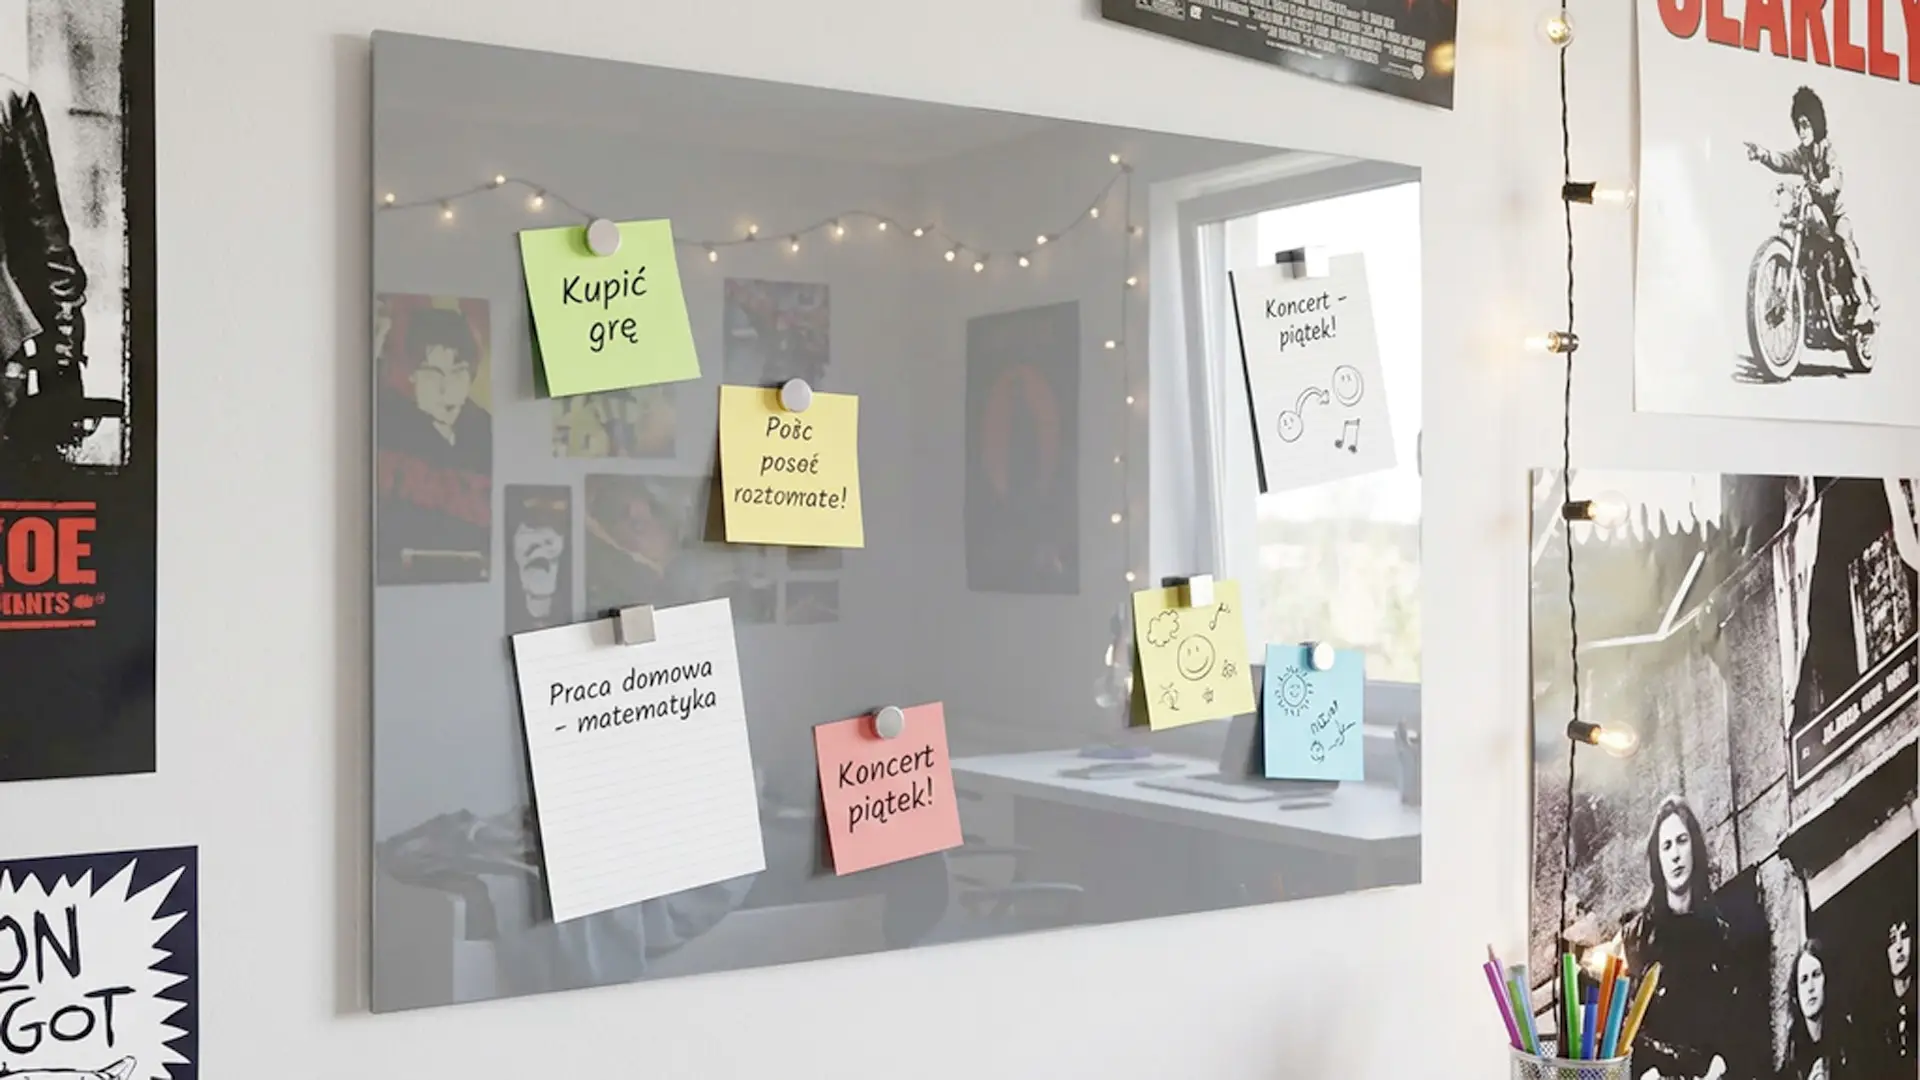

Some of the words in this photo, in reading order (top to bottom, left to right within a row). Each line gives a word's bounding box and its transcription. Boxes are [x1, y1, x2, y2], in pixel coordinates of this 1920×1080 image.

[562, 266, 648, 310] Kupić
[1265, 291, 1332, 319] Koncert
[589, 317, 639, 353] grę
[1279, 316, 1337, 352] piątek!
[0, 516, 97, 585] OE
[550, 679, 612, 706] Praca
[622, 660, 713, 692] domowa
[577, 688, 717, 733] matematyka
[838, 744, 935, 789] Koncert
[849, 776, 933, 833] piątek!
[0, 986, 137, 1055] GOT
